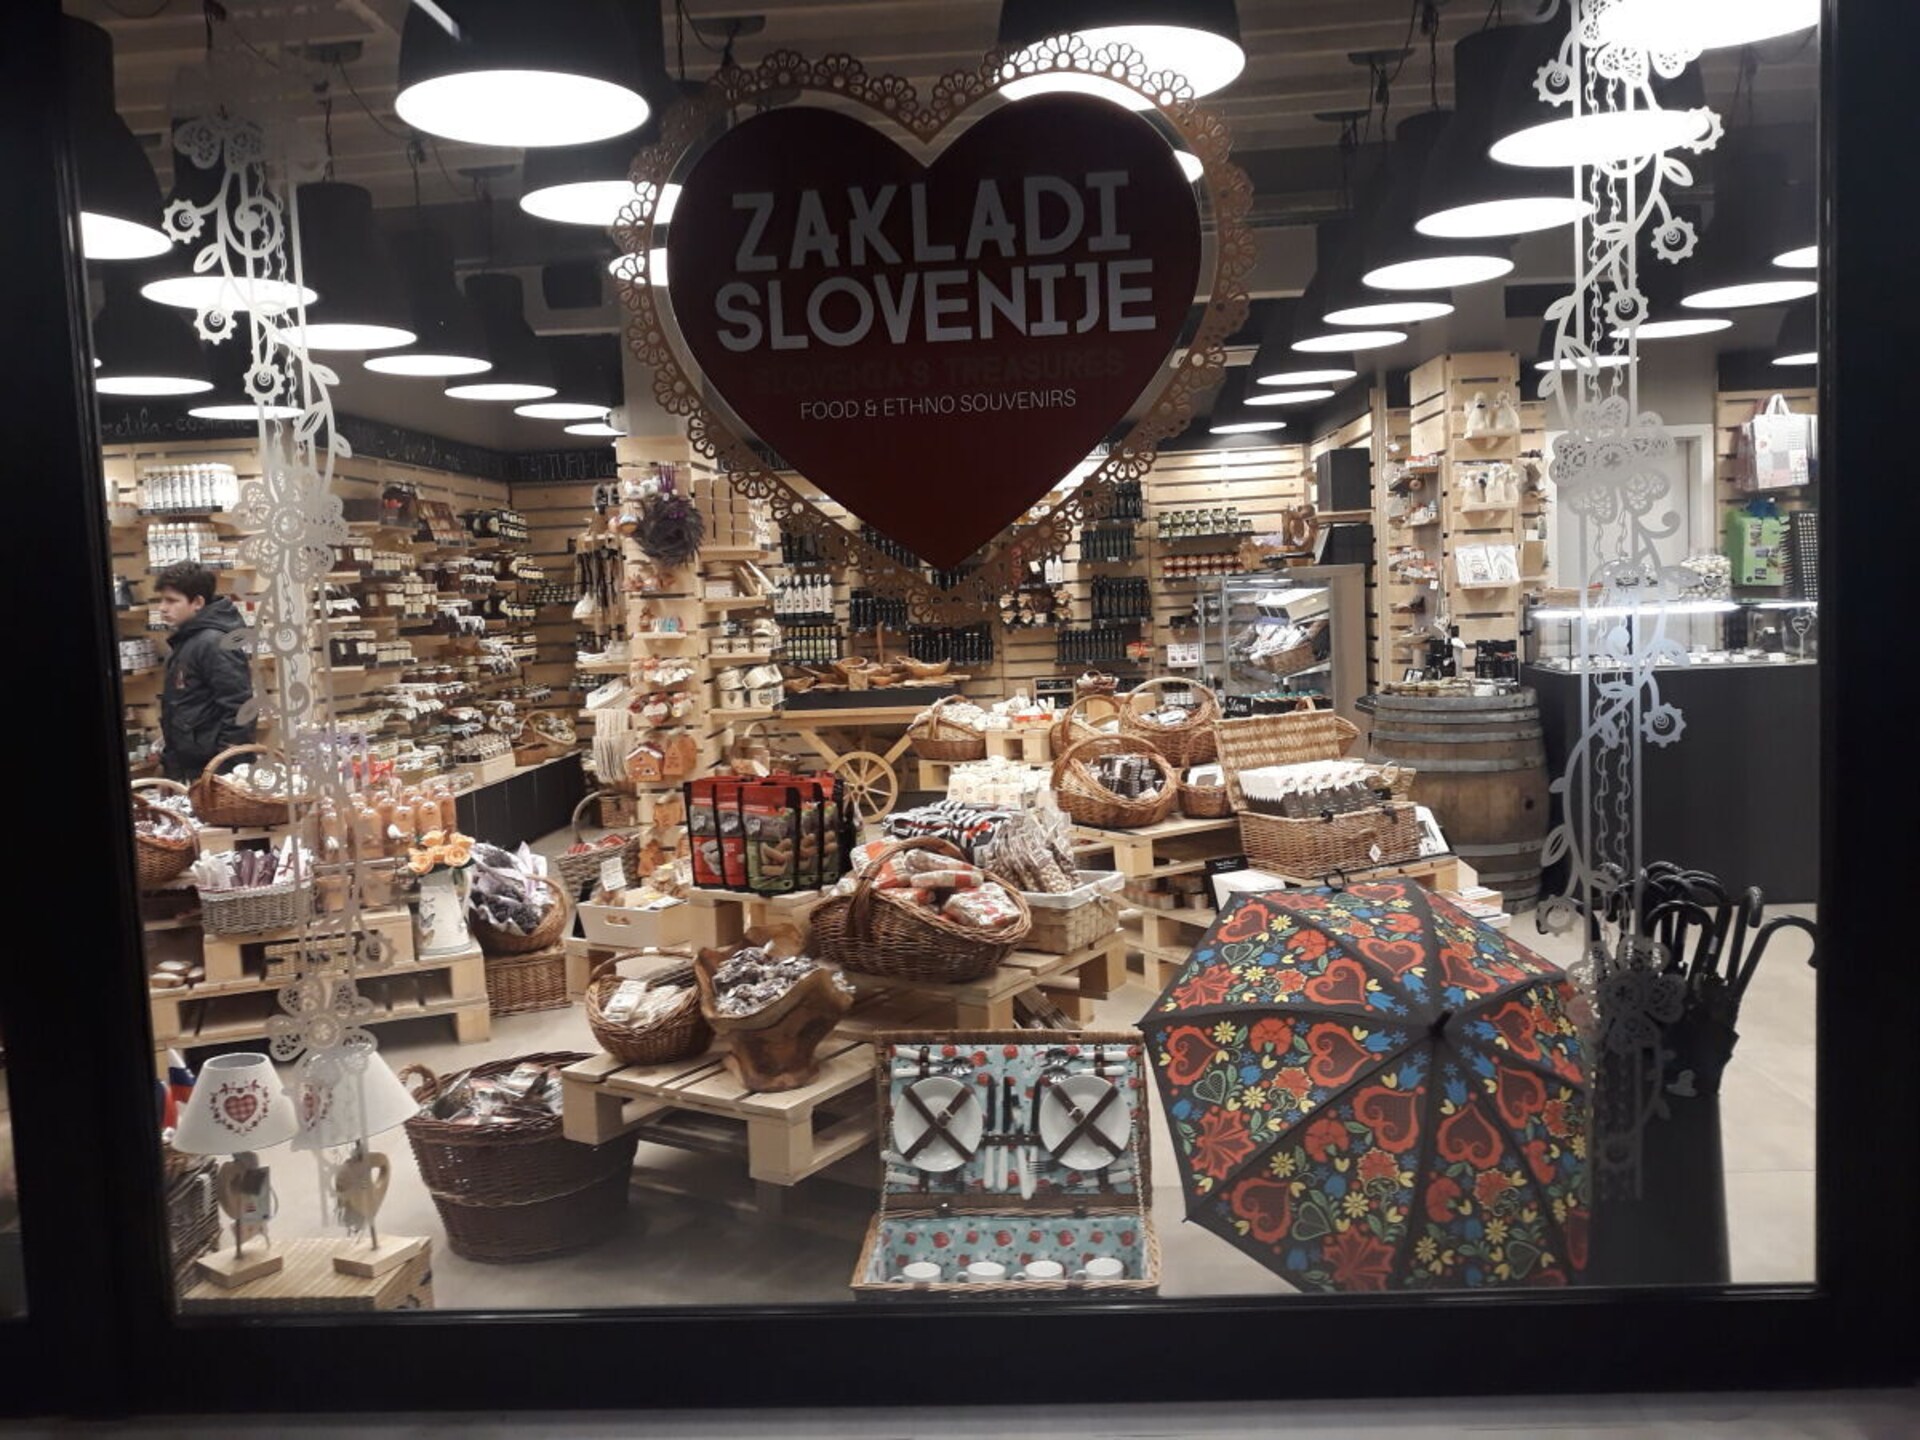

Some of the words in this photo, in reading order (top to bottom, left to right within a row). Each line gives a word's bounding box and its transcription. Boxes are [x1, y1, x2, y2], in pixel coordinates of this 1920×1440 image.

[732, 170, 1131, 273] ZAKLADI
[715, 259, 1157, 352] SLOVENIJE
[944, 348, 1126, 386] TREASURES
[800, 400, 860, 420] FOOD
[864, 401, 878, 417] &
[883, 394, 956, 417] ETHNO
[960, 388, 1077, 413] SOUVENIRS
